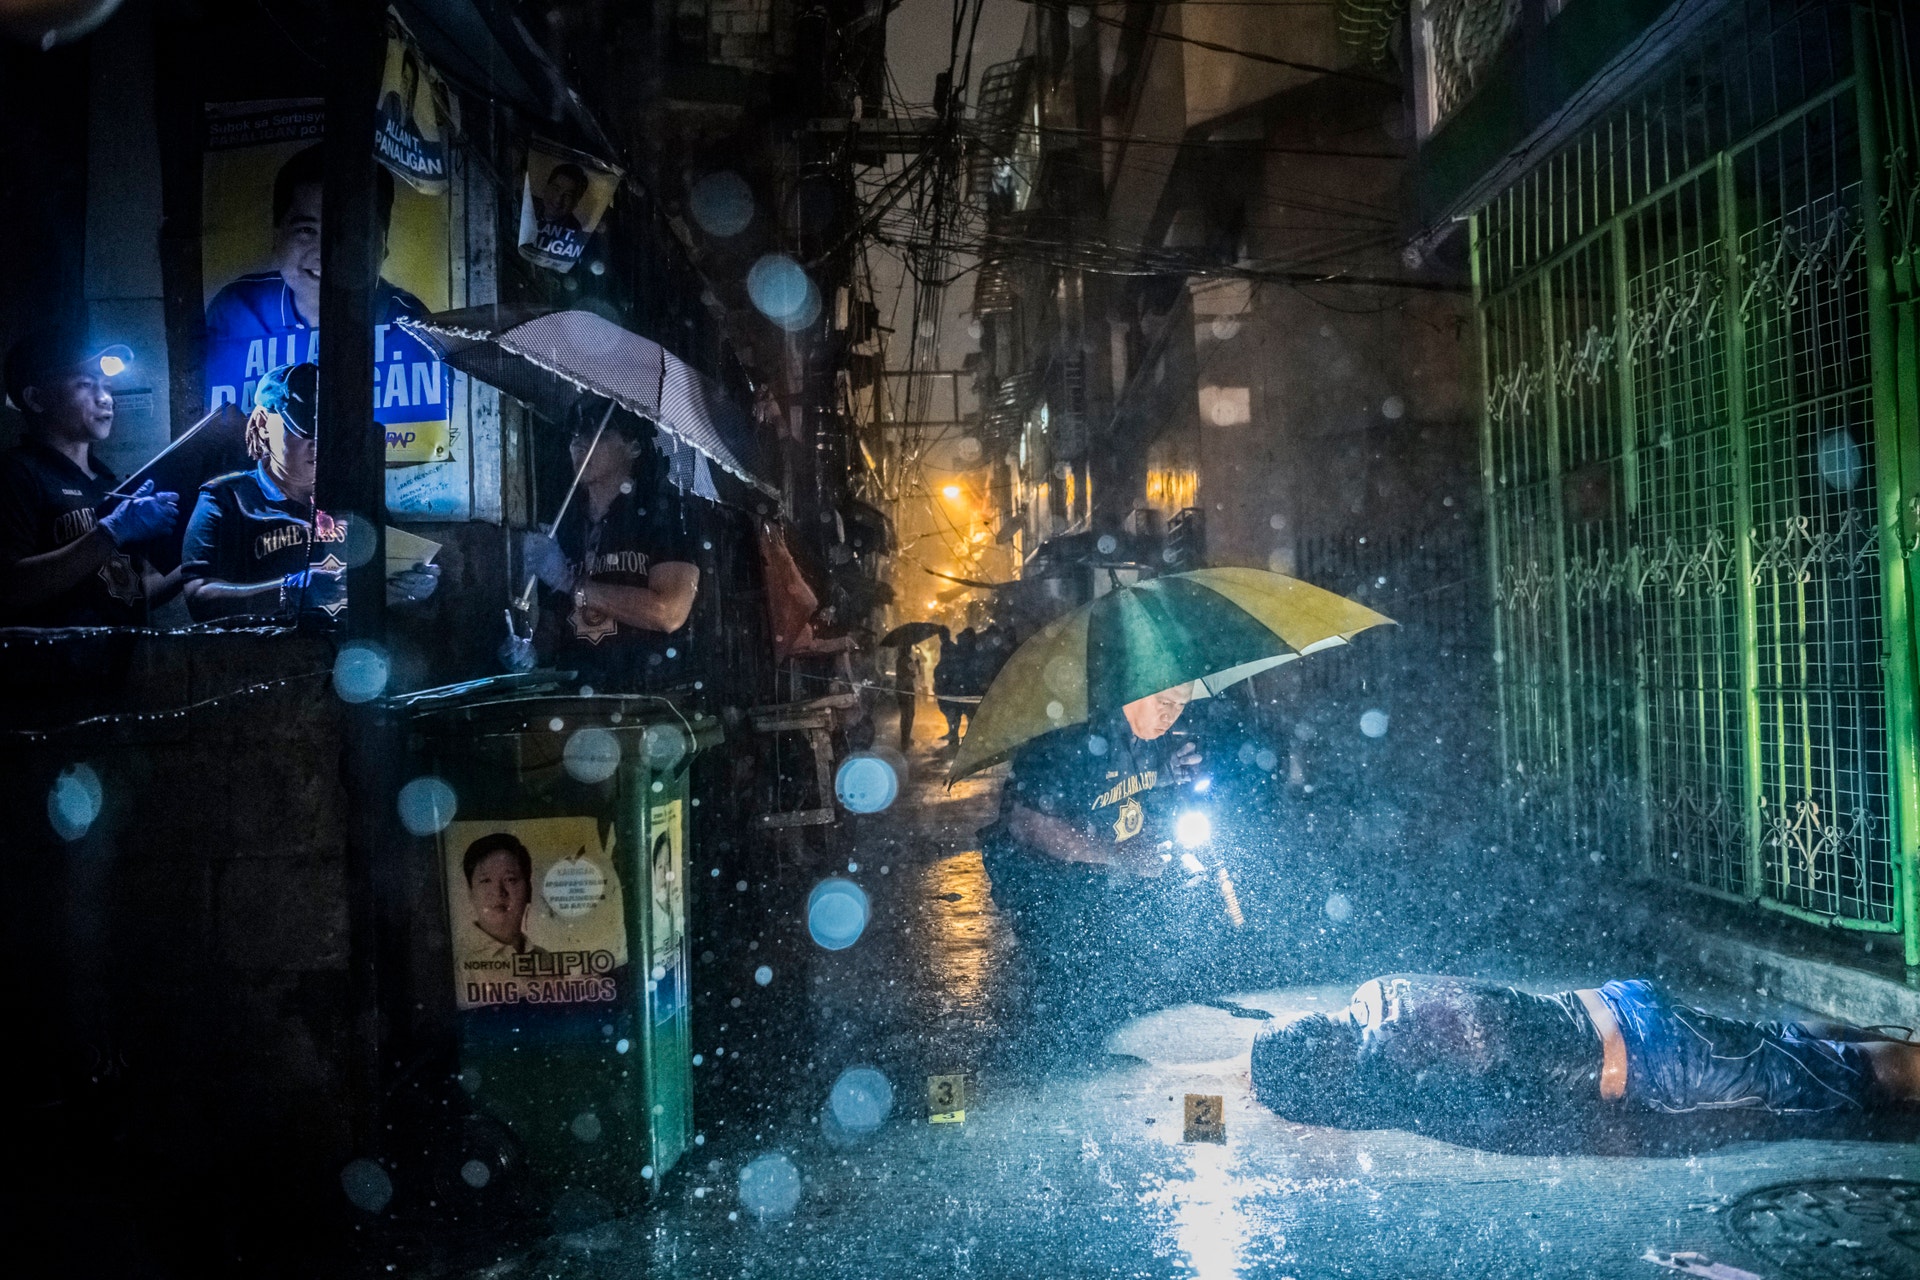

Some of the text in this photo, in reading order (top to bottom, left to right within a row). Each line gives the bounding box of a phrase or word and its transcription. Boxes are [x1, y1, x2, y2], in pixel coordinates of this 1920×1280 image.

[385, 118, 411, 149] ALLAN
[374, 129, 443, 175] PANALIGAN
[536, 236, 585, 258] LIGAN
[254, 525, 303, 560] CRIME
[464, 949, 615, 977] NORTON ELIPIO
[466, 977, 617, 1004] DING SANTOS
[938, 1081, 954, 1106] 3
[1194, 1099, 1211, 1125] 2
